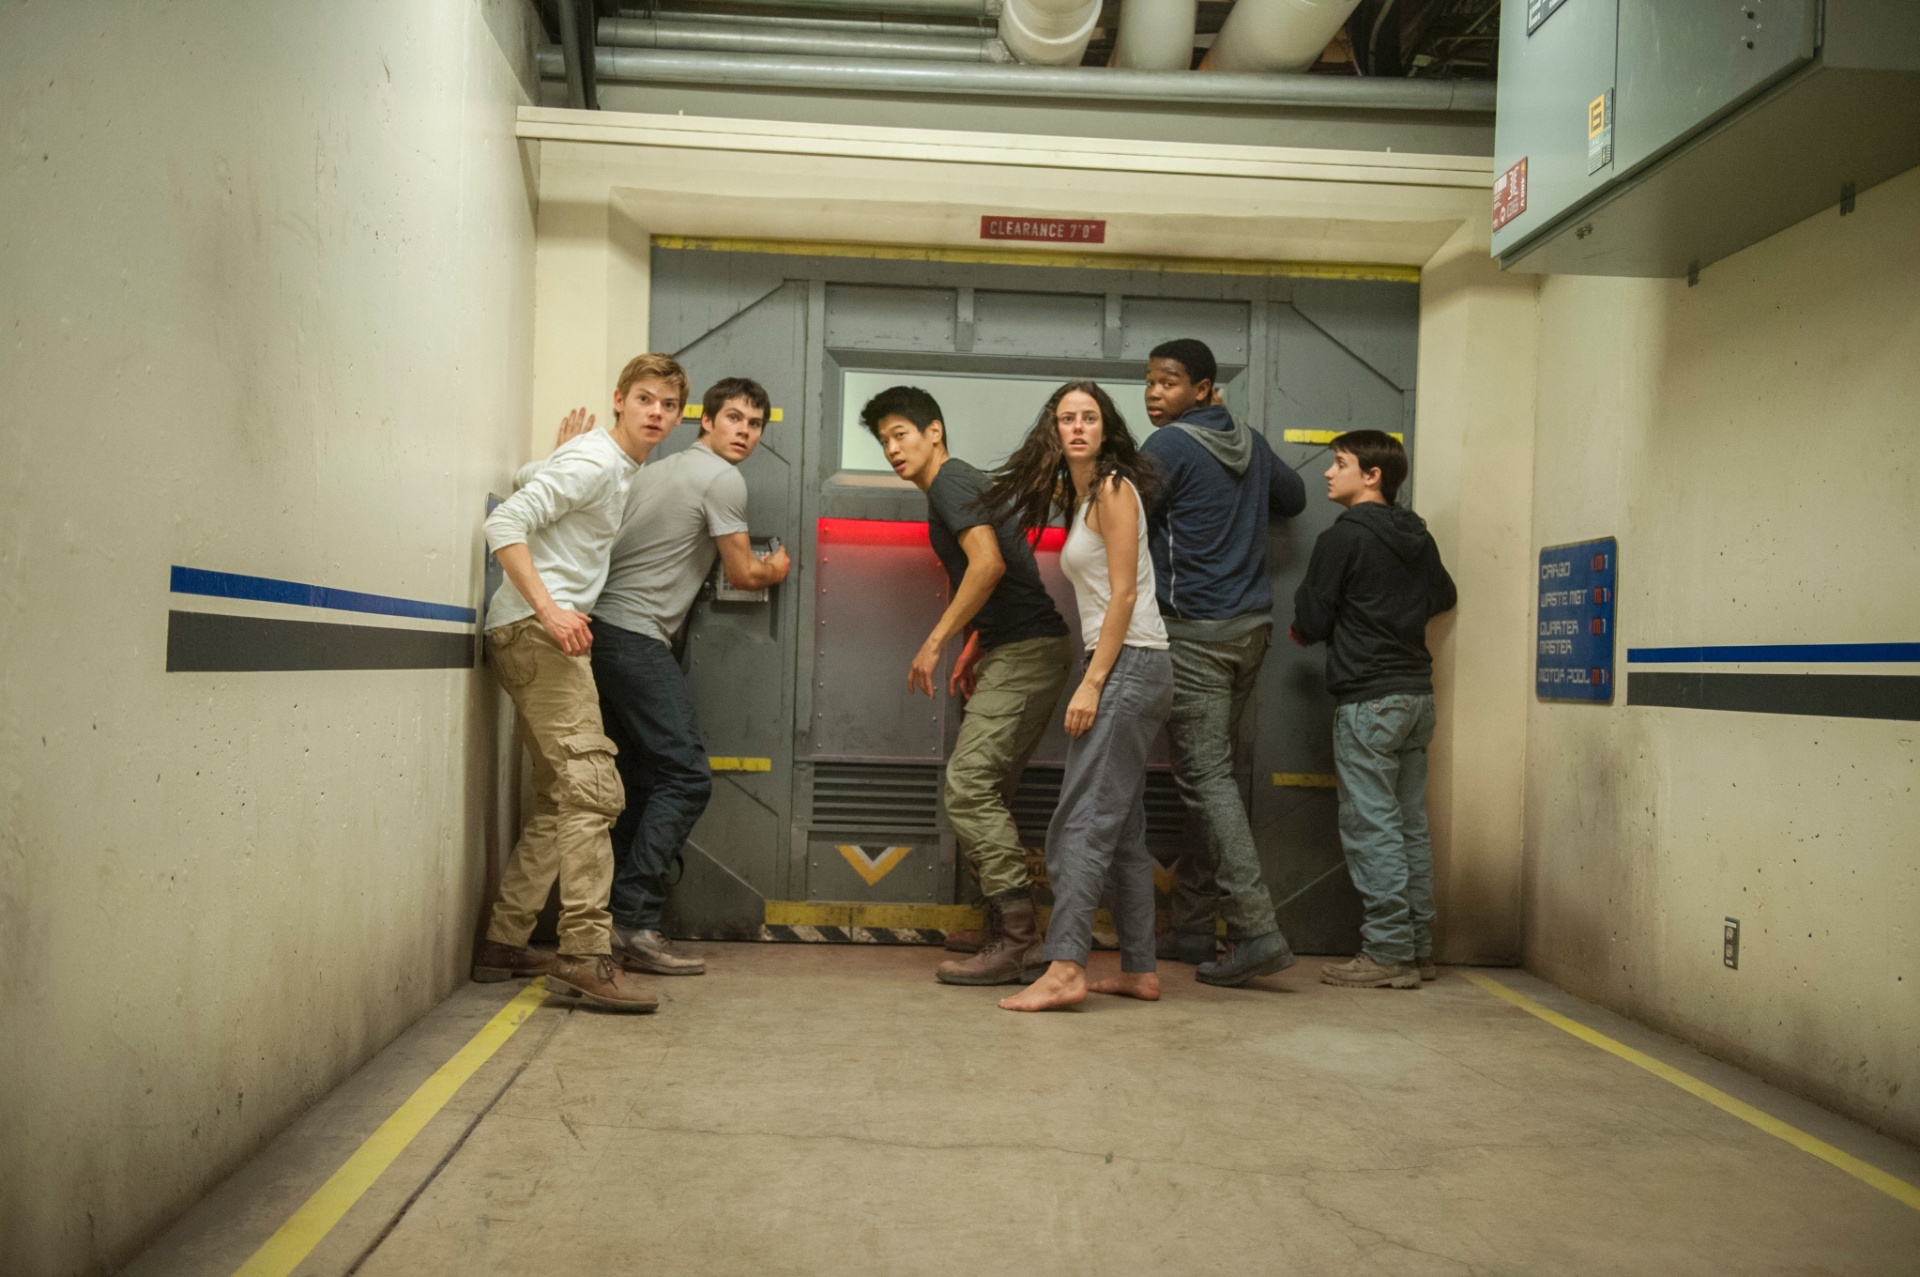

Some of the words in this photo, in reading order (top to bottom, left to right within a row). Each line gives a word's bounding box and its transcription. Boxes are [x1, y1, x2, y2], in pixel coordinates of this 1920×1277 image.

[989, 221, 1065, 238] CLEARANCE
[1541, 561, 1571, 579] CARGO
[1541, 591, 1568, 608] WASTE
[1540, 620, 1579, 636] QUARTER
[1539, 639, 1572, 655] MASTER
[1538, 668, 1565, 683] MOTOR
[1566, 668, 1590, 684] POOL
